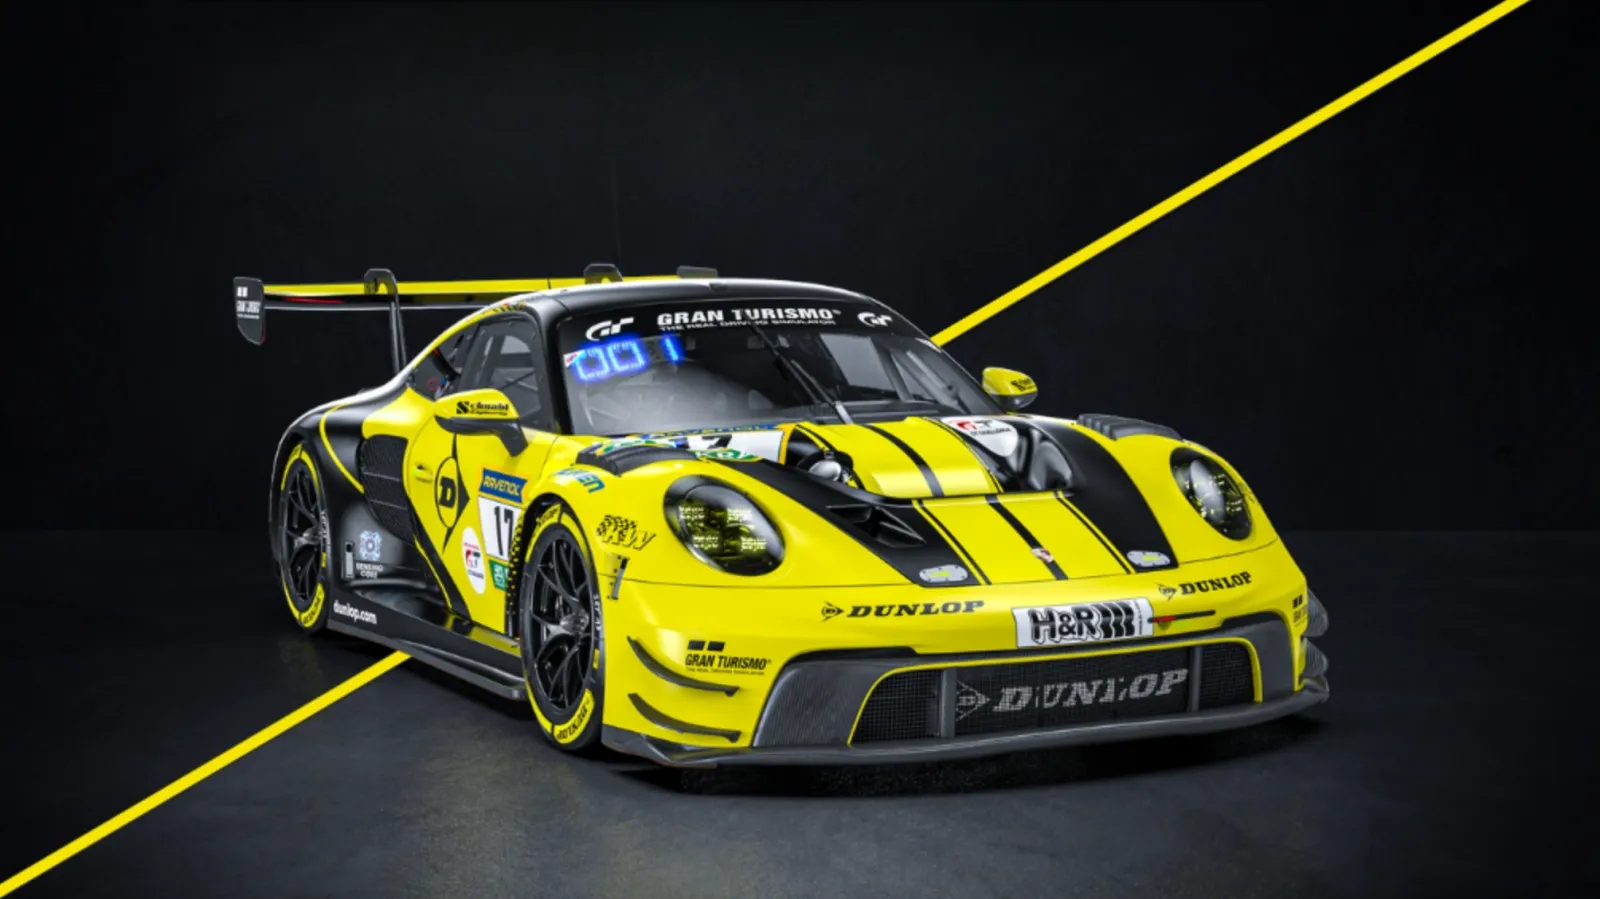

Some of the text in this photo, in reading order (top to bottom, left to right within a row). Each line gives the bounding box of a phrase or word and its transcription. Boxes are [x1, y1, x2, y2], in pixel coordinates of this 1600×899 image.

[657, 310, 724, 326] GRAN
[484, 475, 520, 497] RAVENOL
[494, 506, 514, 561] 17
[1178, 571, 1252, 595] DUNLOP
[333, 600, 377, 625] dunlop.com
[846, 600, 984, 618] DUNLOP
[1029, 607, 1100, 643] H&R
[685, 654, 715, 667] GRAN
[993, 669, 1188, 713] DUNLOP
